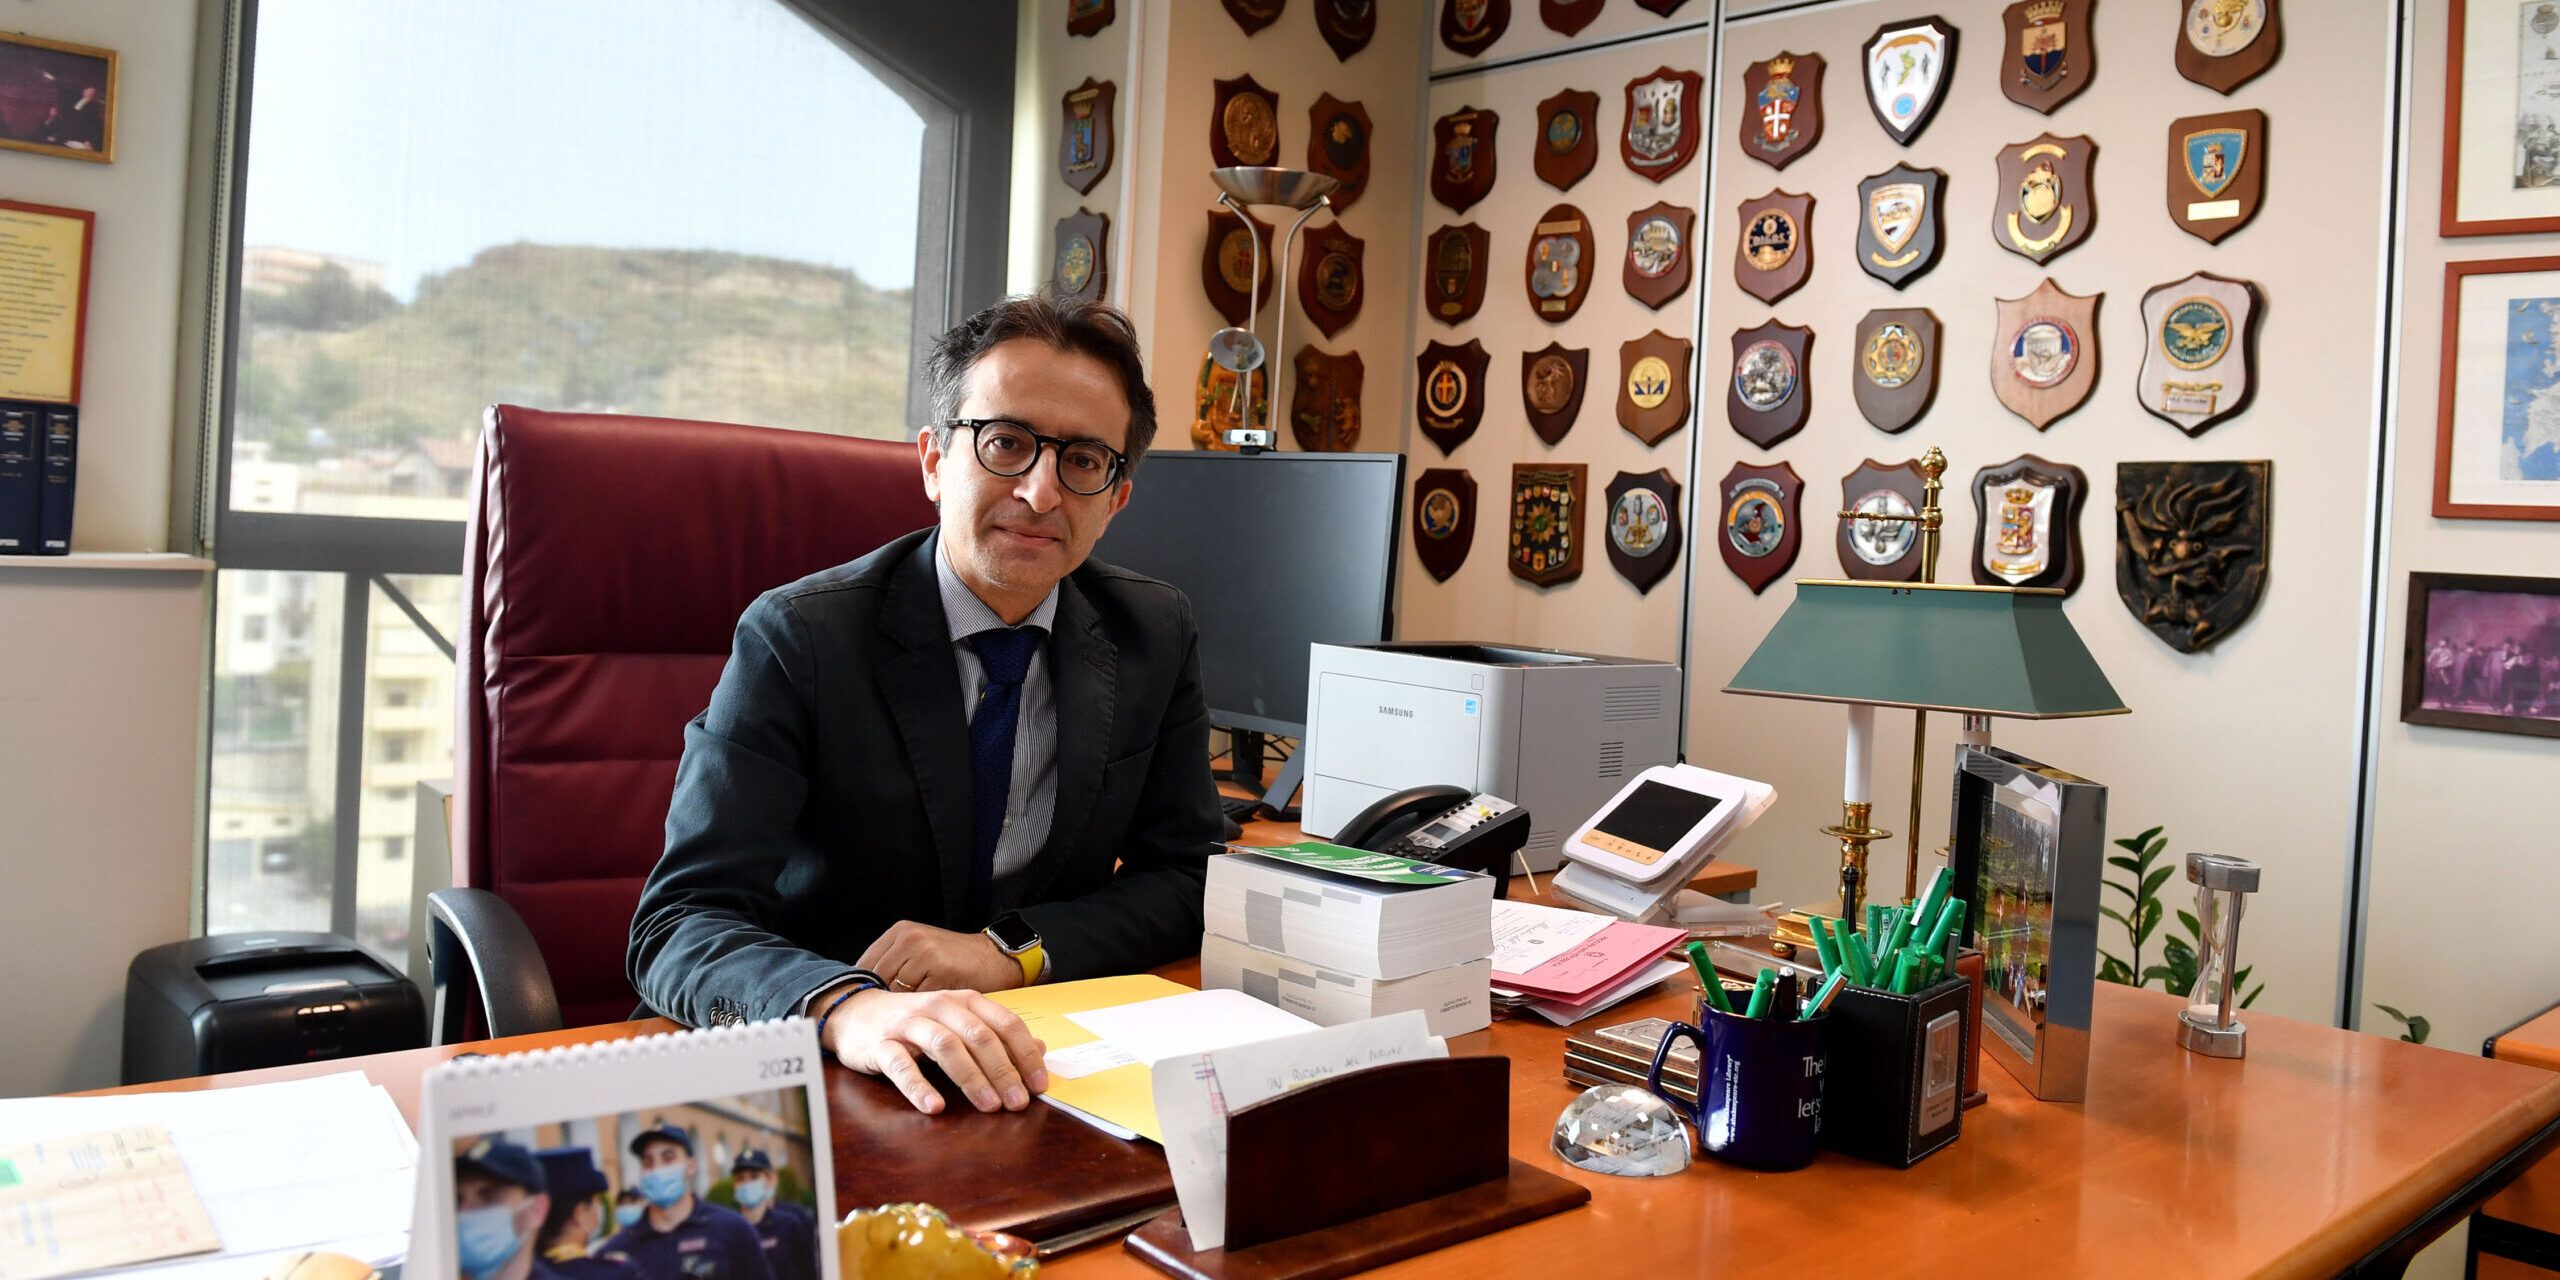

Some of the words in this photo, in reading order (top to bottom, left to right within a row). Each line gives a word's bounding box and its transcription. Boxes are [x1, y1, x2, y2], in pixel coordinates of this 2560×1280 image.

[1379, 706, 1414, 718] SAMSUNG
[760, 1056, 804, 1079] 2022
[1803, 1056, 1824, 1077] The
[1730, 1061, 1741, 1142] www.shakespeare-etc.org
